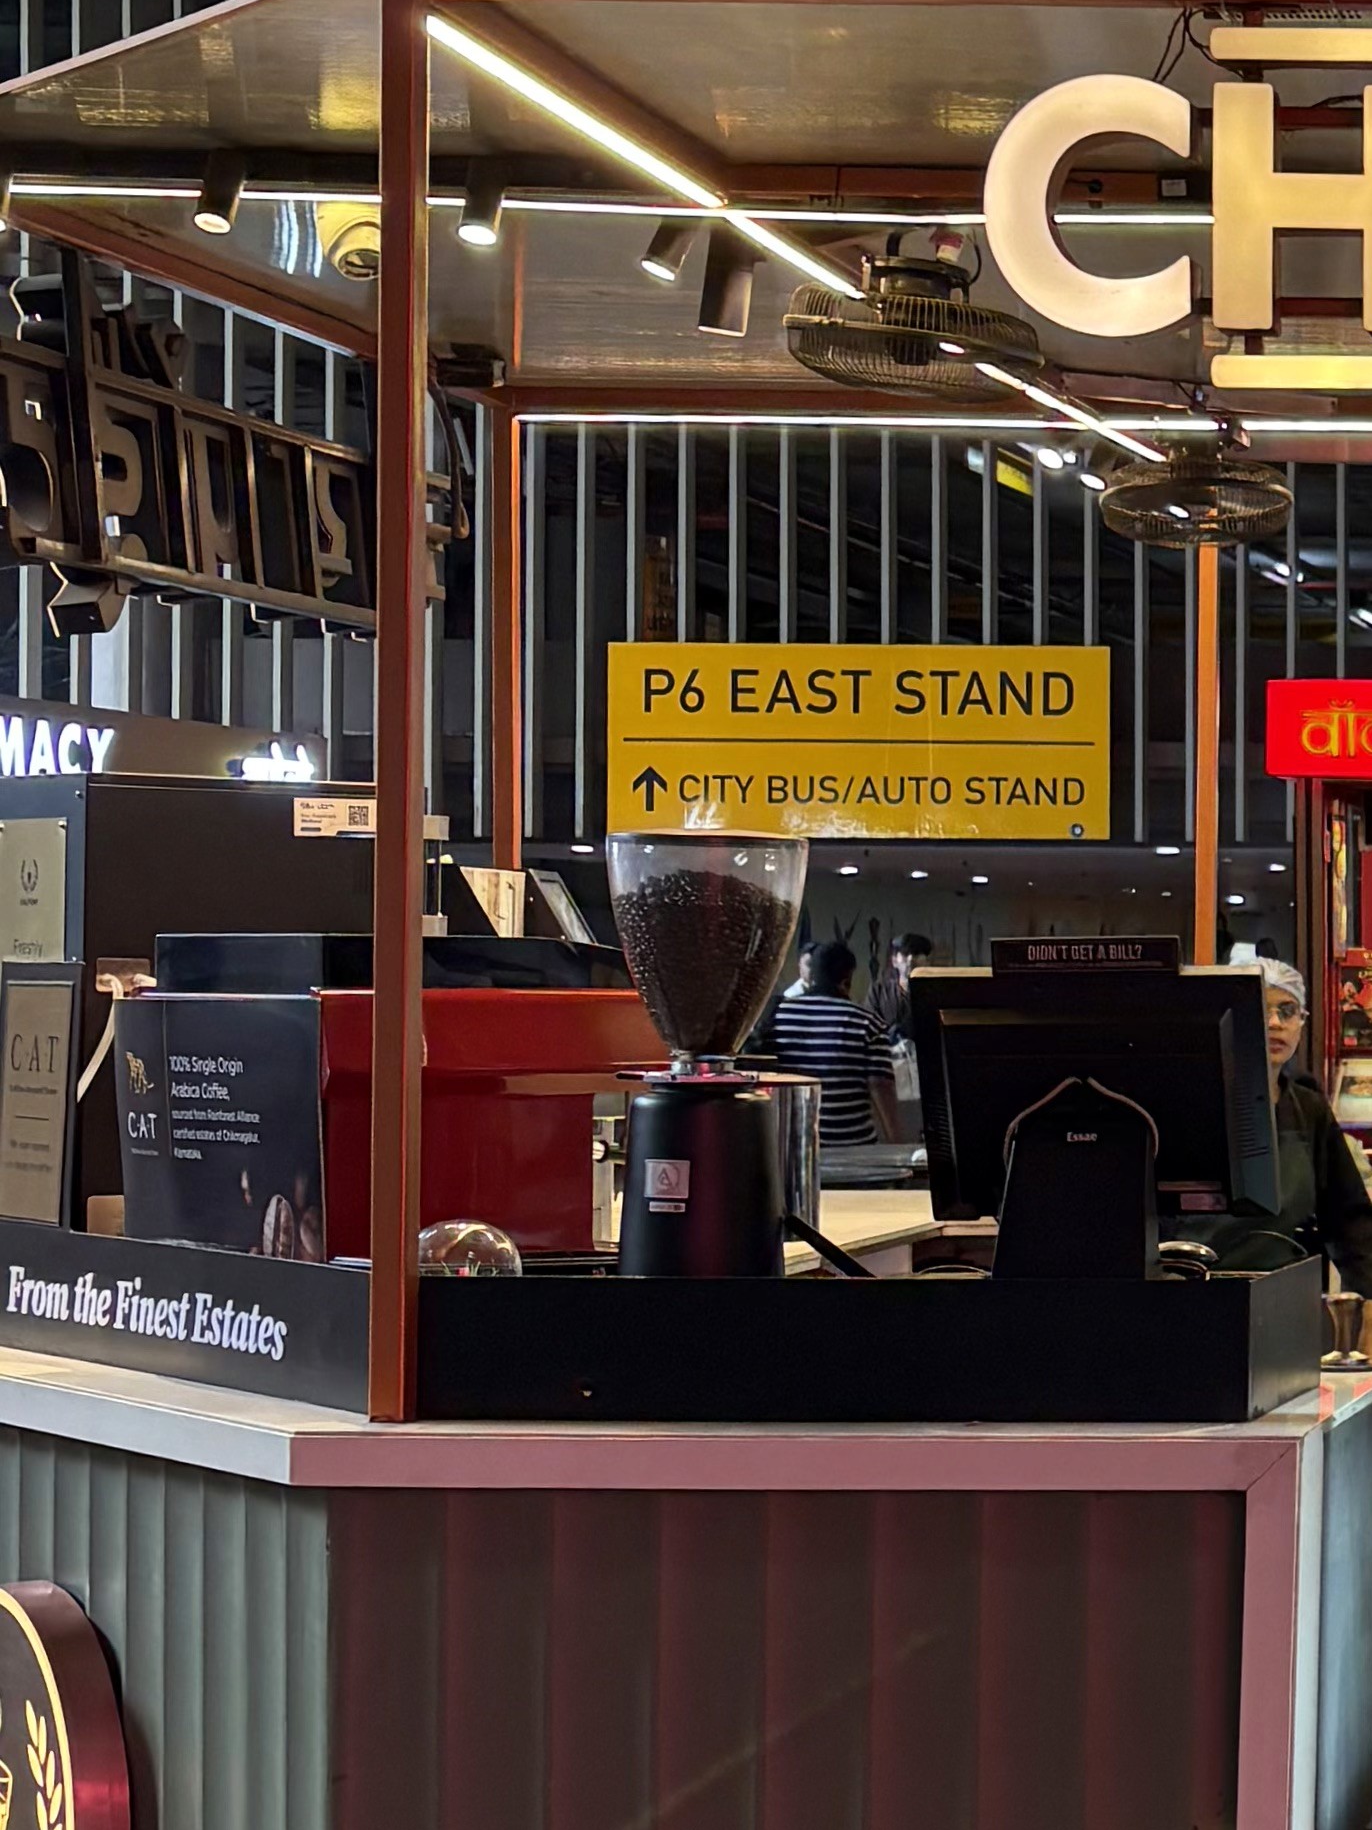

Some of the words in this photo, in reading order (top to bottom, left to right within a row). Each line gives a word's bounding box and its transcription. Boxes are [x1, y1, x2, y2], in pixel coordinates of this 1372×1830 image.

[643, 668, 705, 714] P6
[731, 669, 872, 716] EAST
[894, 670, 1075, 718] STAND
[0, 716, 114, 776] MACY
[678, 774, 755, 805] CITY
[766, 775, 953, 806] BUS/AUTO
[964, 777, 1086, 807] STAND
[1028, 944, 1068, 961] DIDN'T
[1071, 944, 1095, 960] GET
[1097, 944, 1107, 960] A
[1108, 944, 1143, 960] BILL?
[169, 1055, 191, 1072] 100%
[191, 1056, 217, 1077] Single
[218, 1057, 244, 1077] Origin
[171, 1081, 200, 1099] Arabica
[201, 1082, 231, 1101] Coffee,
[6, 1265, 69, 1321] From
[73, 1272, 112, 1327] the
[113, 1276, 190, 1342] Finest
[191, 1292, 288, 1361] Estates
